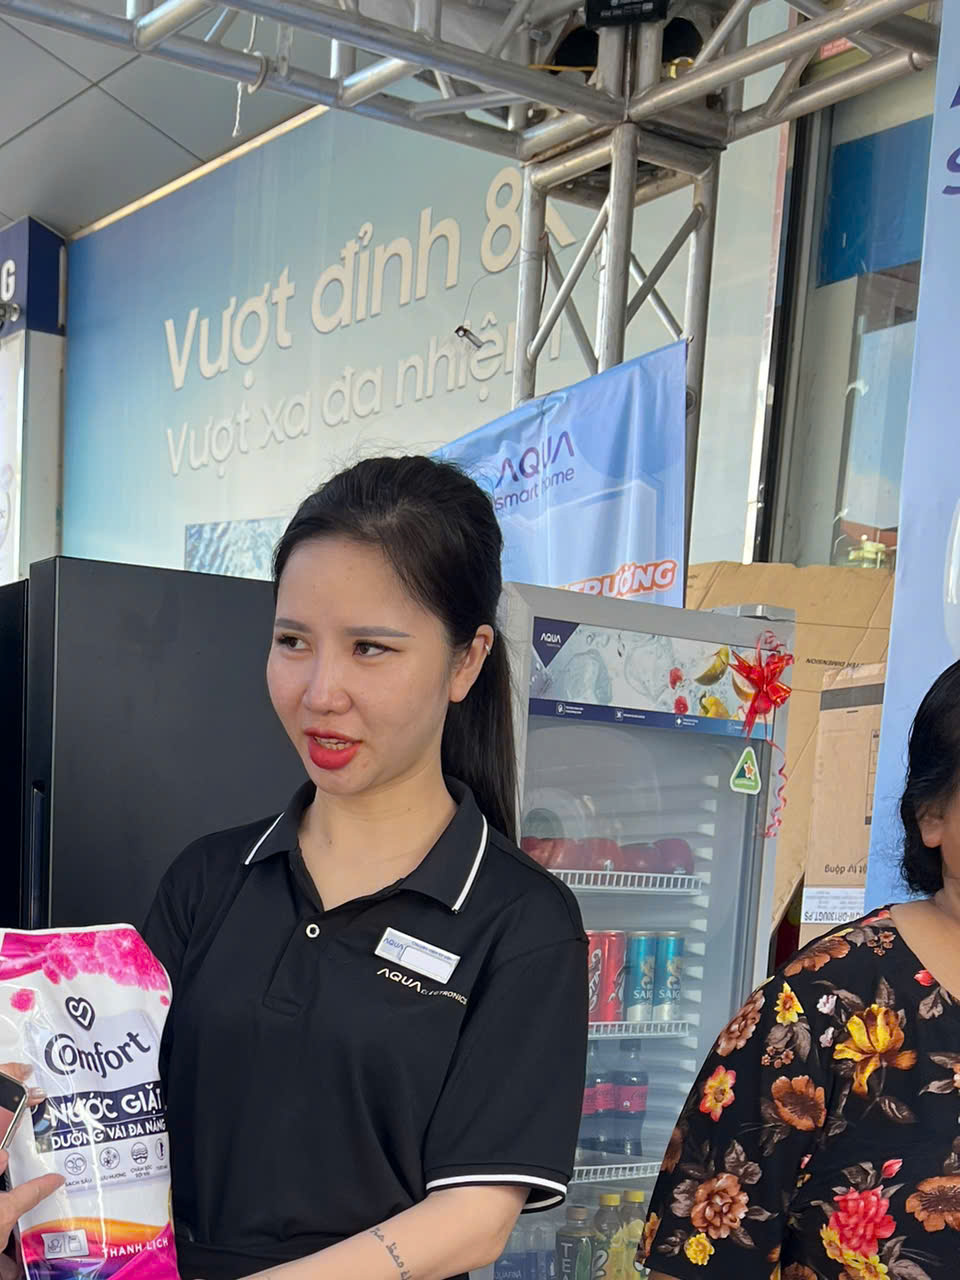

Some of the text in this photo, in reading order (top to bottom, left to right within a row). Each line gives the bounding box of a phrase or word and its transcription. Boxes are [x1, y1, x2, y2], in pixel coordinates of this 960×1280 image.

[164, 265, 297, 390] Vượt
[311, 206, 461, 334] đỉnh
[167, 404, 250, 480] Vượt
[260, 391, 312, 450] xa
[321, 364, 385, 428] đa
[495, 430, 575, 489] AQUA
[494, 483, 539, 512] smart
[540, 632, 562, 644] AQUA
[377, 968, 421, 993] AQUA
[44, 1031, 151, 1078] Comfort
